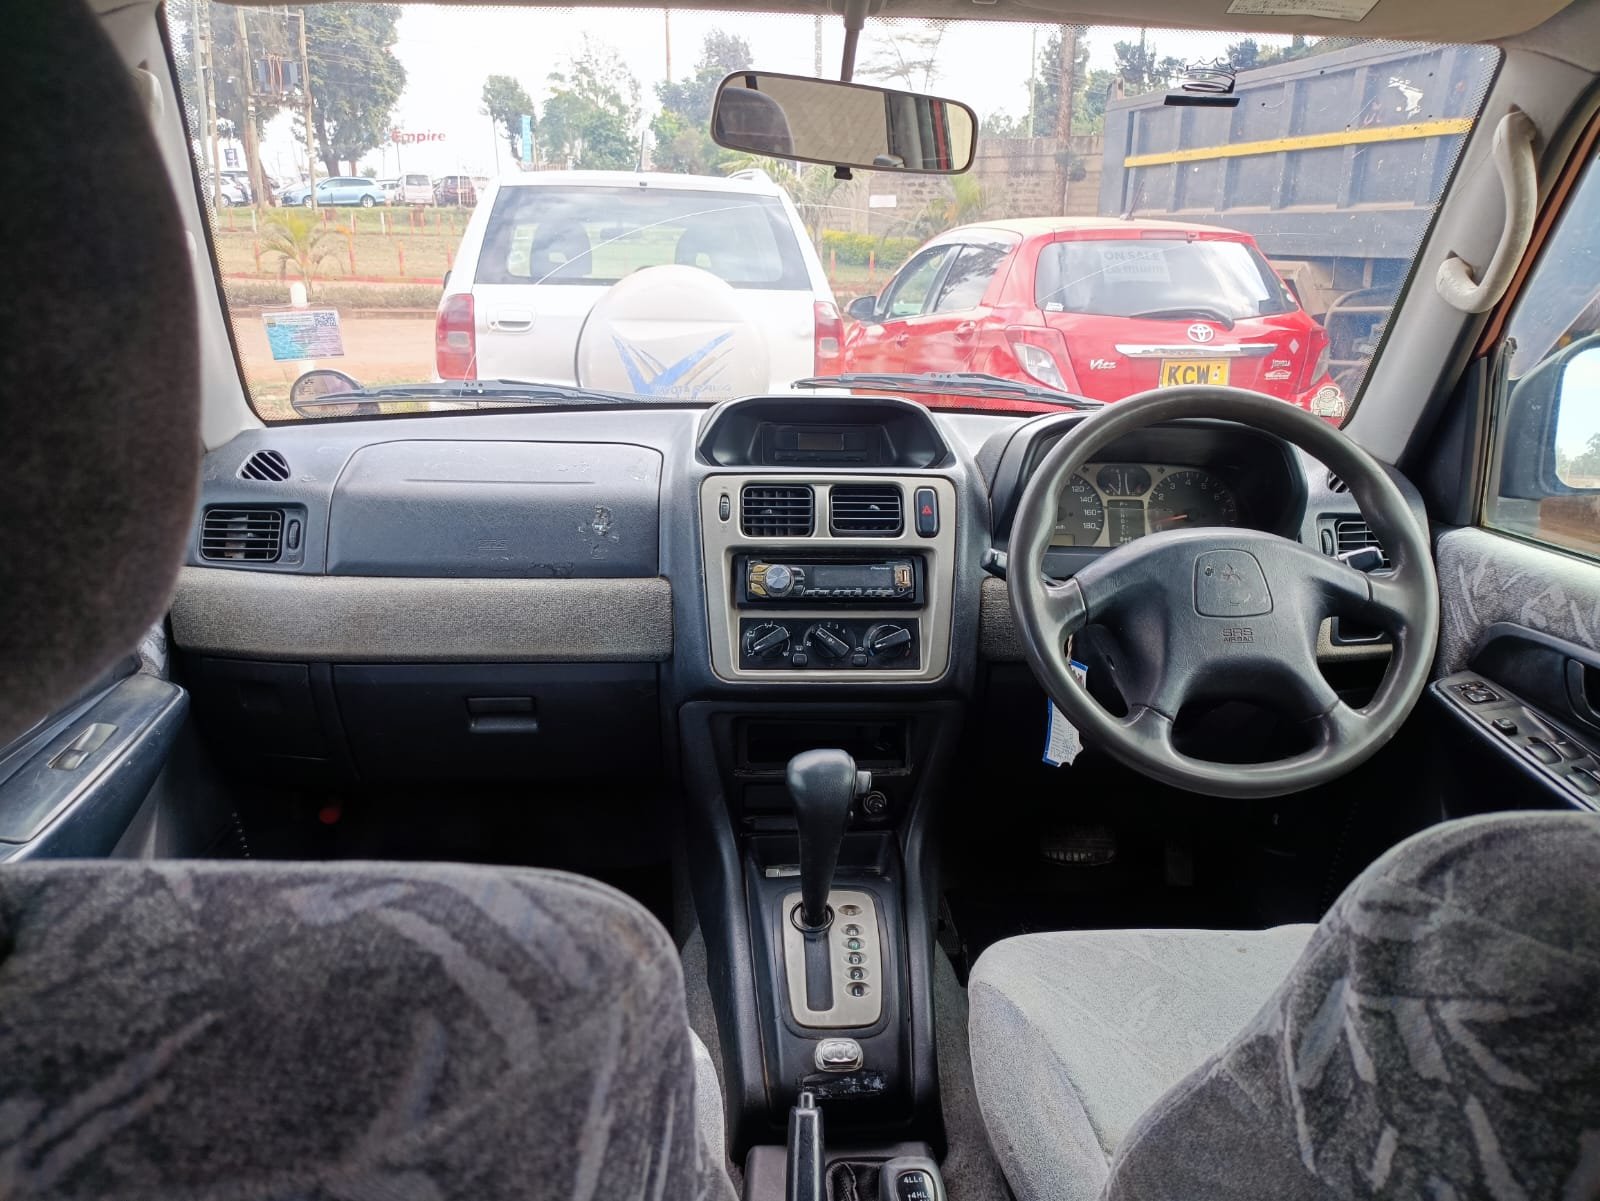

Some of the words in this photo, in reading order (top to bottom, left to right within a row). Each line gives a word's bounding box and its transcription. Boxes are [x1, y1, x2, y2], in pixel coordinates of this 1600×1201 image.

[391, 128, 446, 144] Empire
[1167, 364, 1211, 386] KCW
[1223, 628, 1253, 637] SRS
